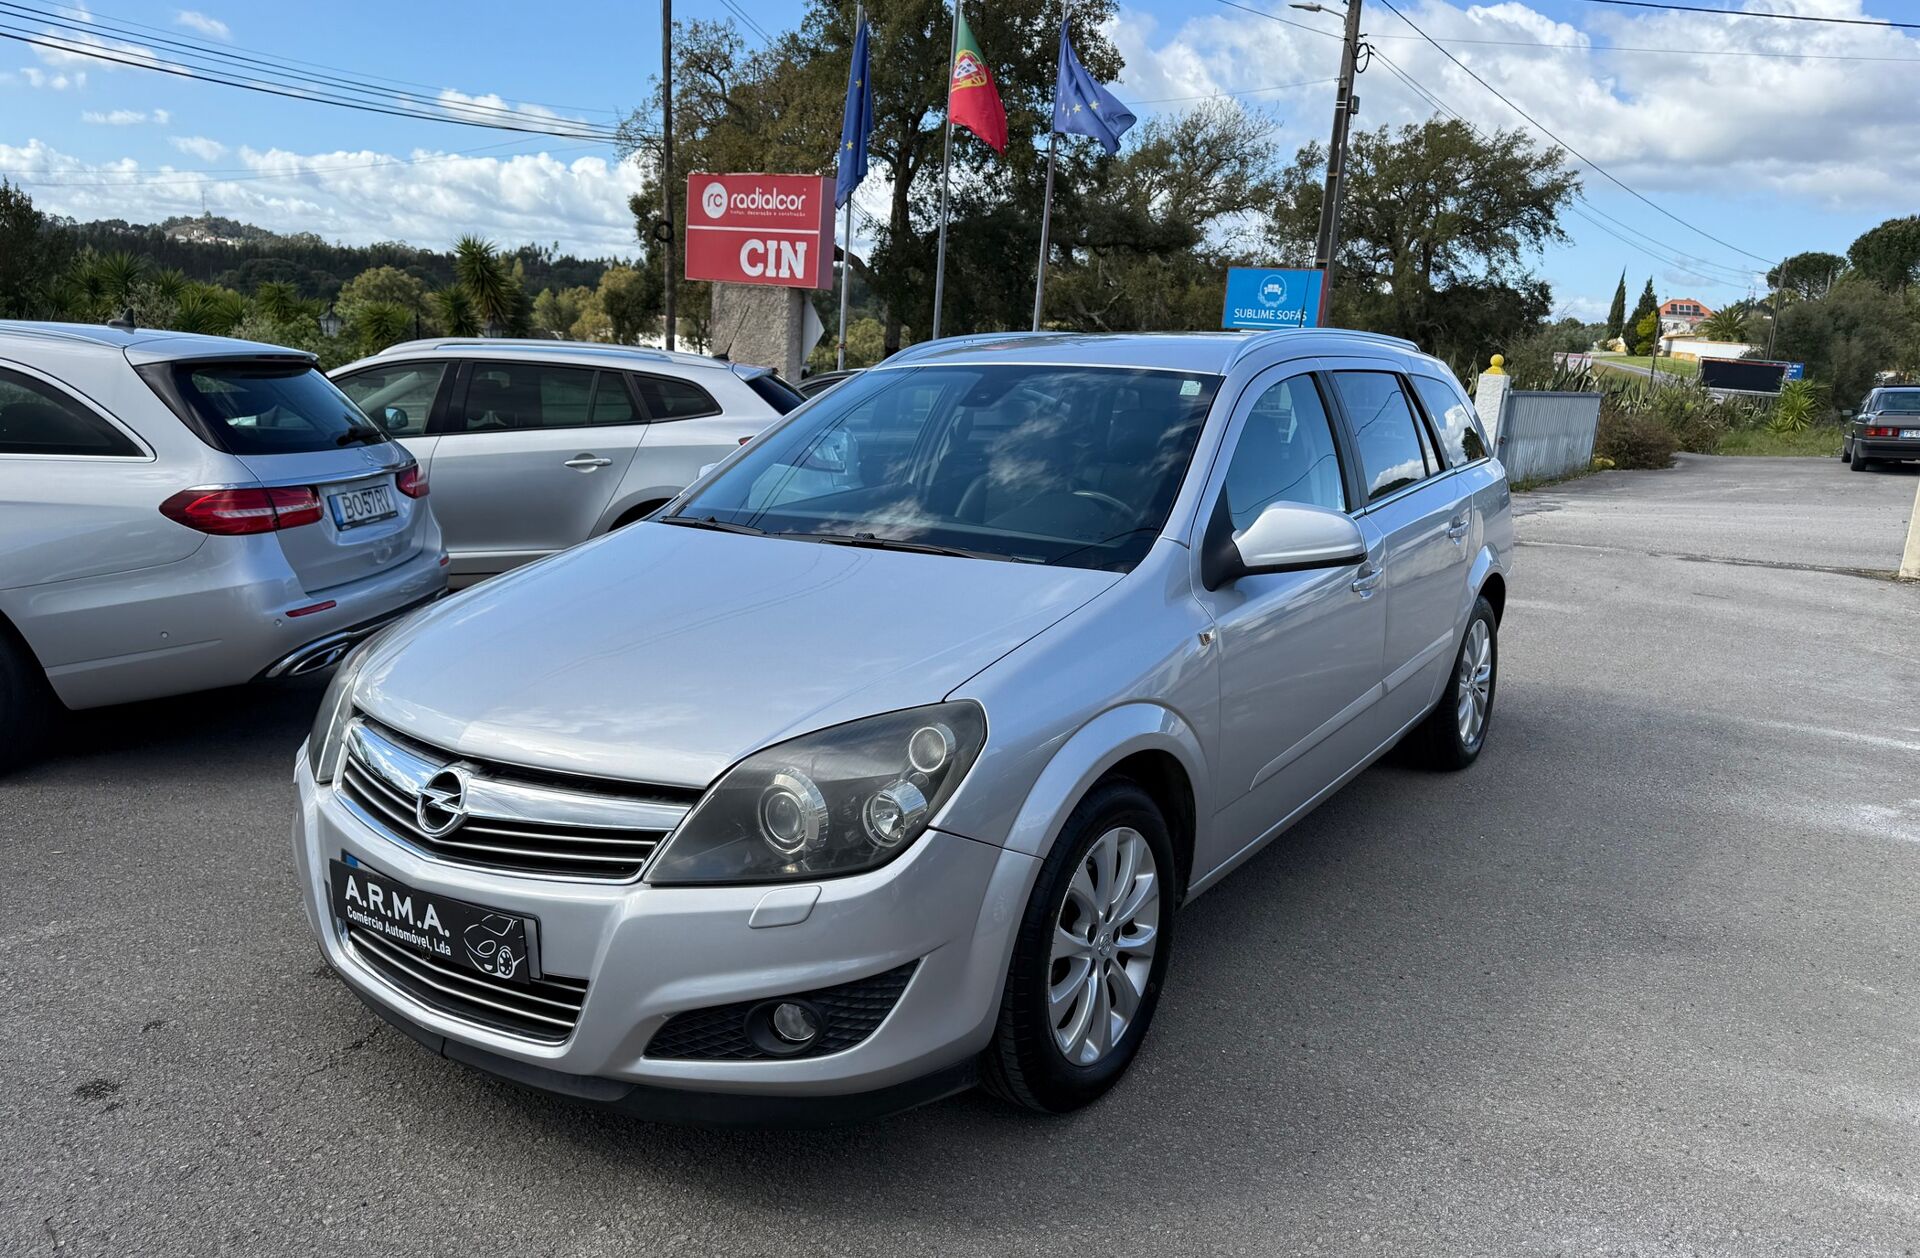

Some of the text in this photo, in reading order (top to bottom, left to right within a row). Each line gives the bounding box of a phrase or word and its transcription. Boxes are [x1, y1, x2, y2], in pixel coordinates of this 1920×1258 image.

[730, 186, 806, 210] radialcor
[740, 238, 807, 279] CIN
[1234, 308, 1275, 320] SUBLIME
[345, 874, 450, 938] A.R.M.A.
[347, 905, 452, 956] Comércio Automóvel, Lda
